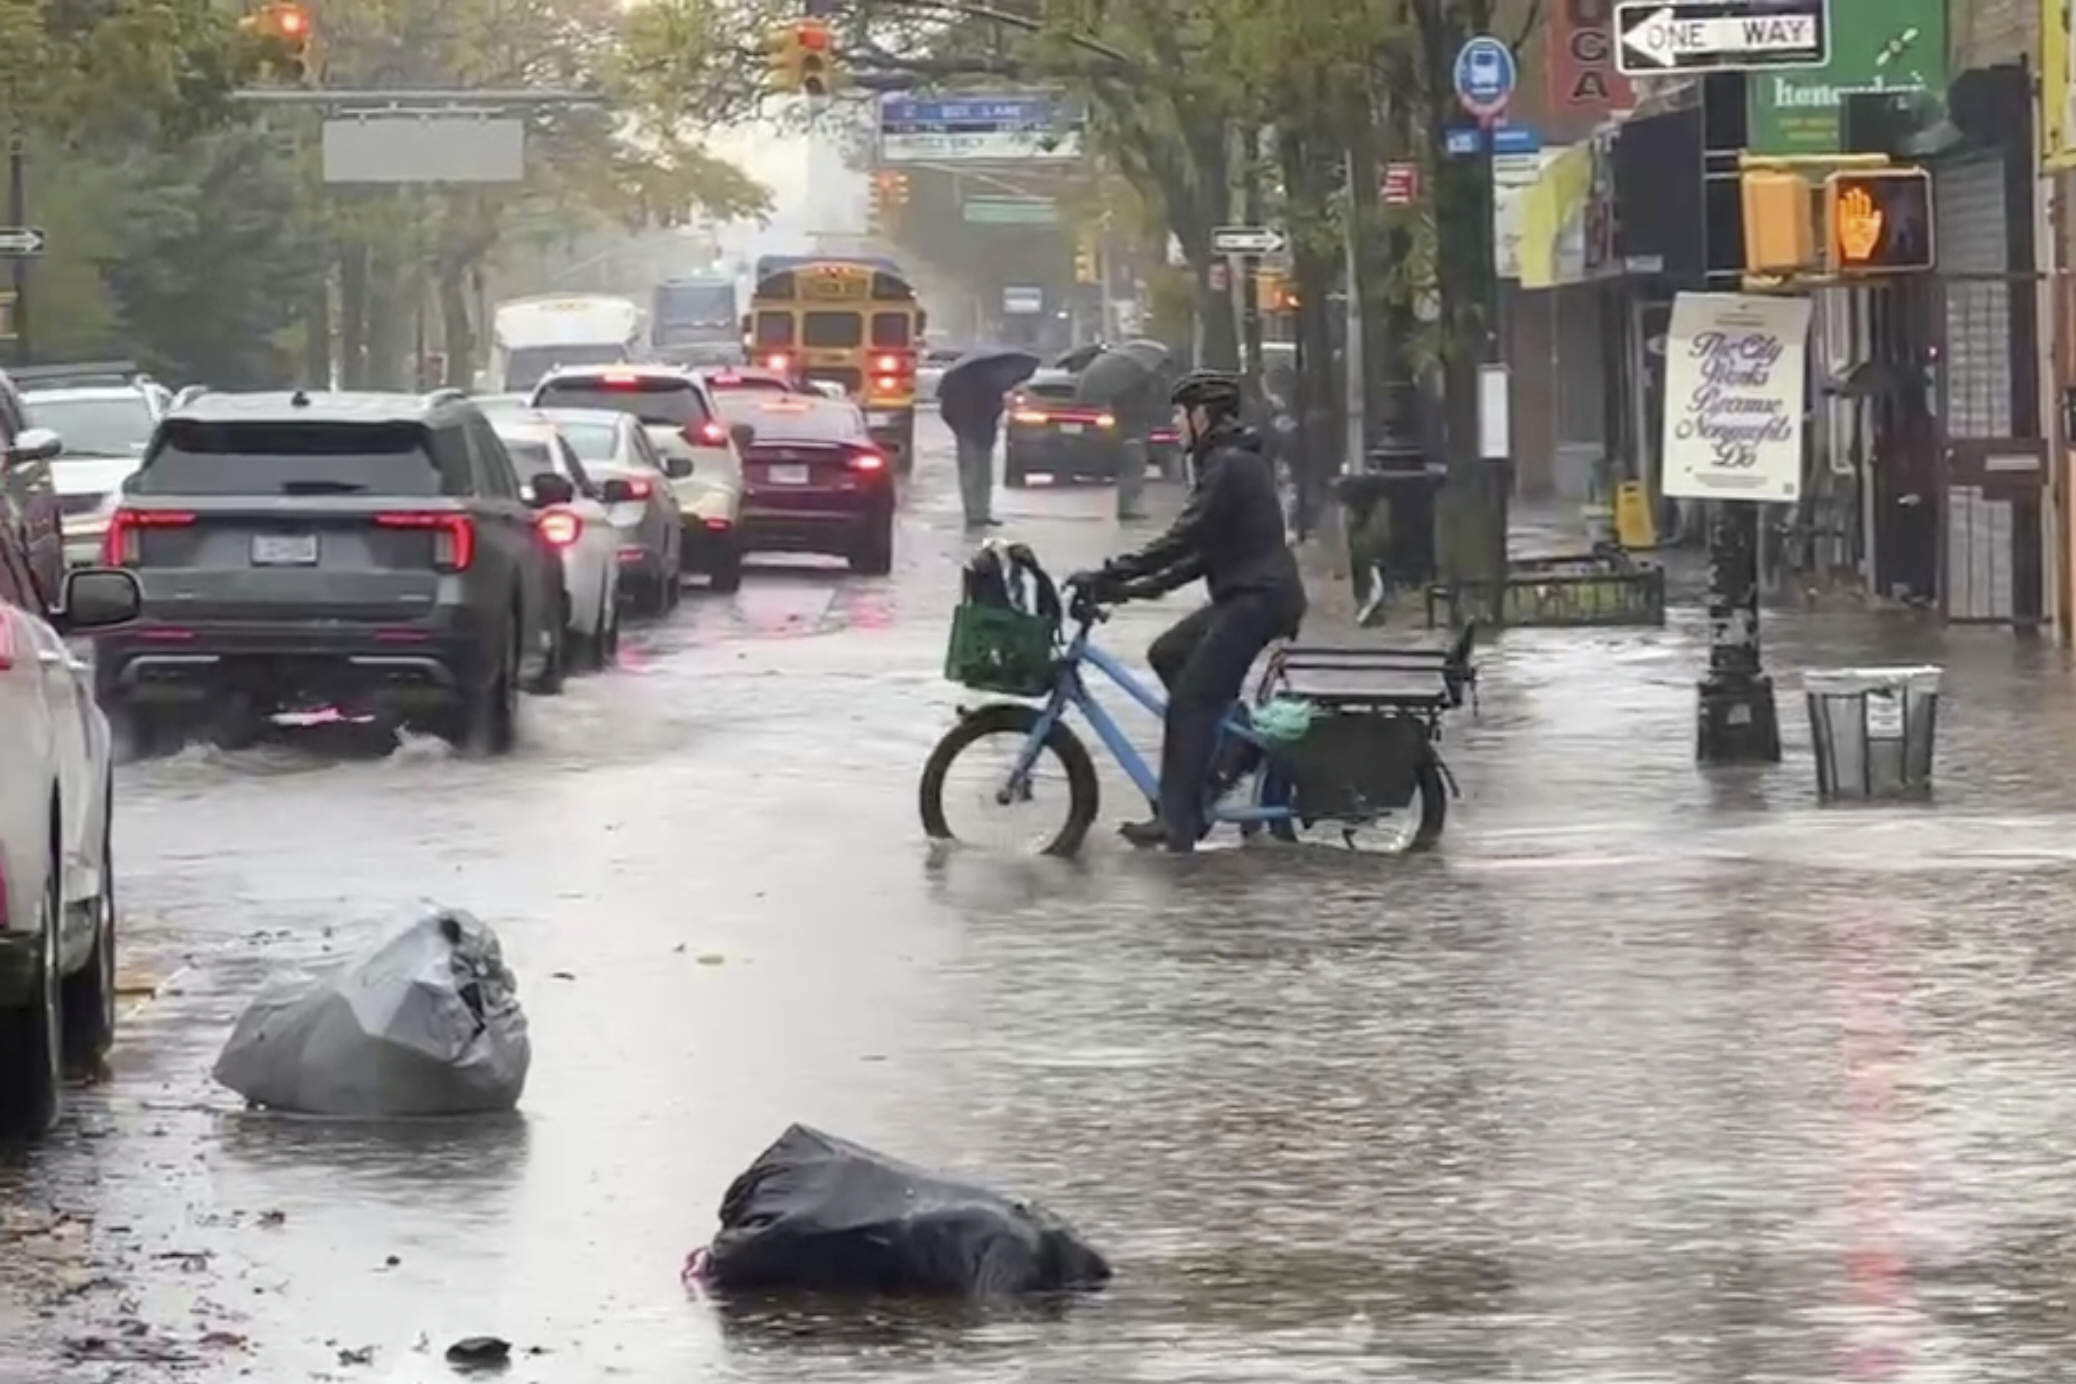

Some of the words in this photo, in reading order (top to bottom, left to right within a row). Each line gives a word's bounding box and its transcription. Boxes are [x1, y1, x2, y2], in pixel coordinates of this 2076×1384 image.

[1647, 23, 1705, 49] ONE
[1742, 18, 1809, 44] WAY
[1688, 332, 1736, 359] The
[1739, 332, 1785, 368] City
[1709, 440, 1757, 468] Do
